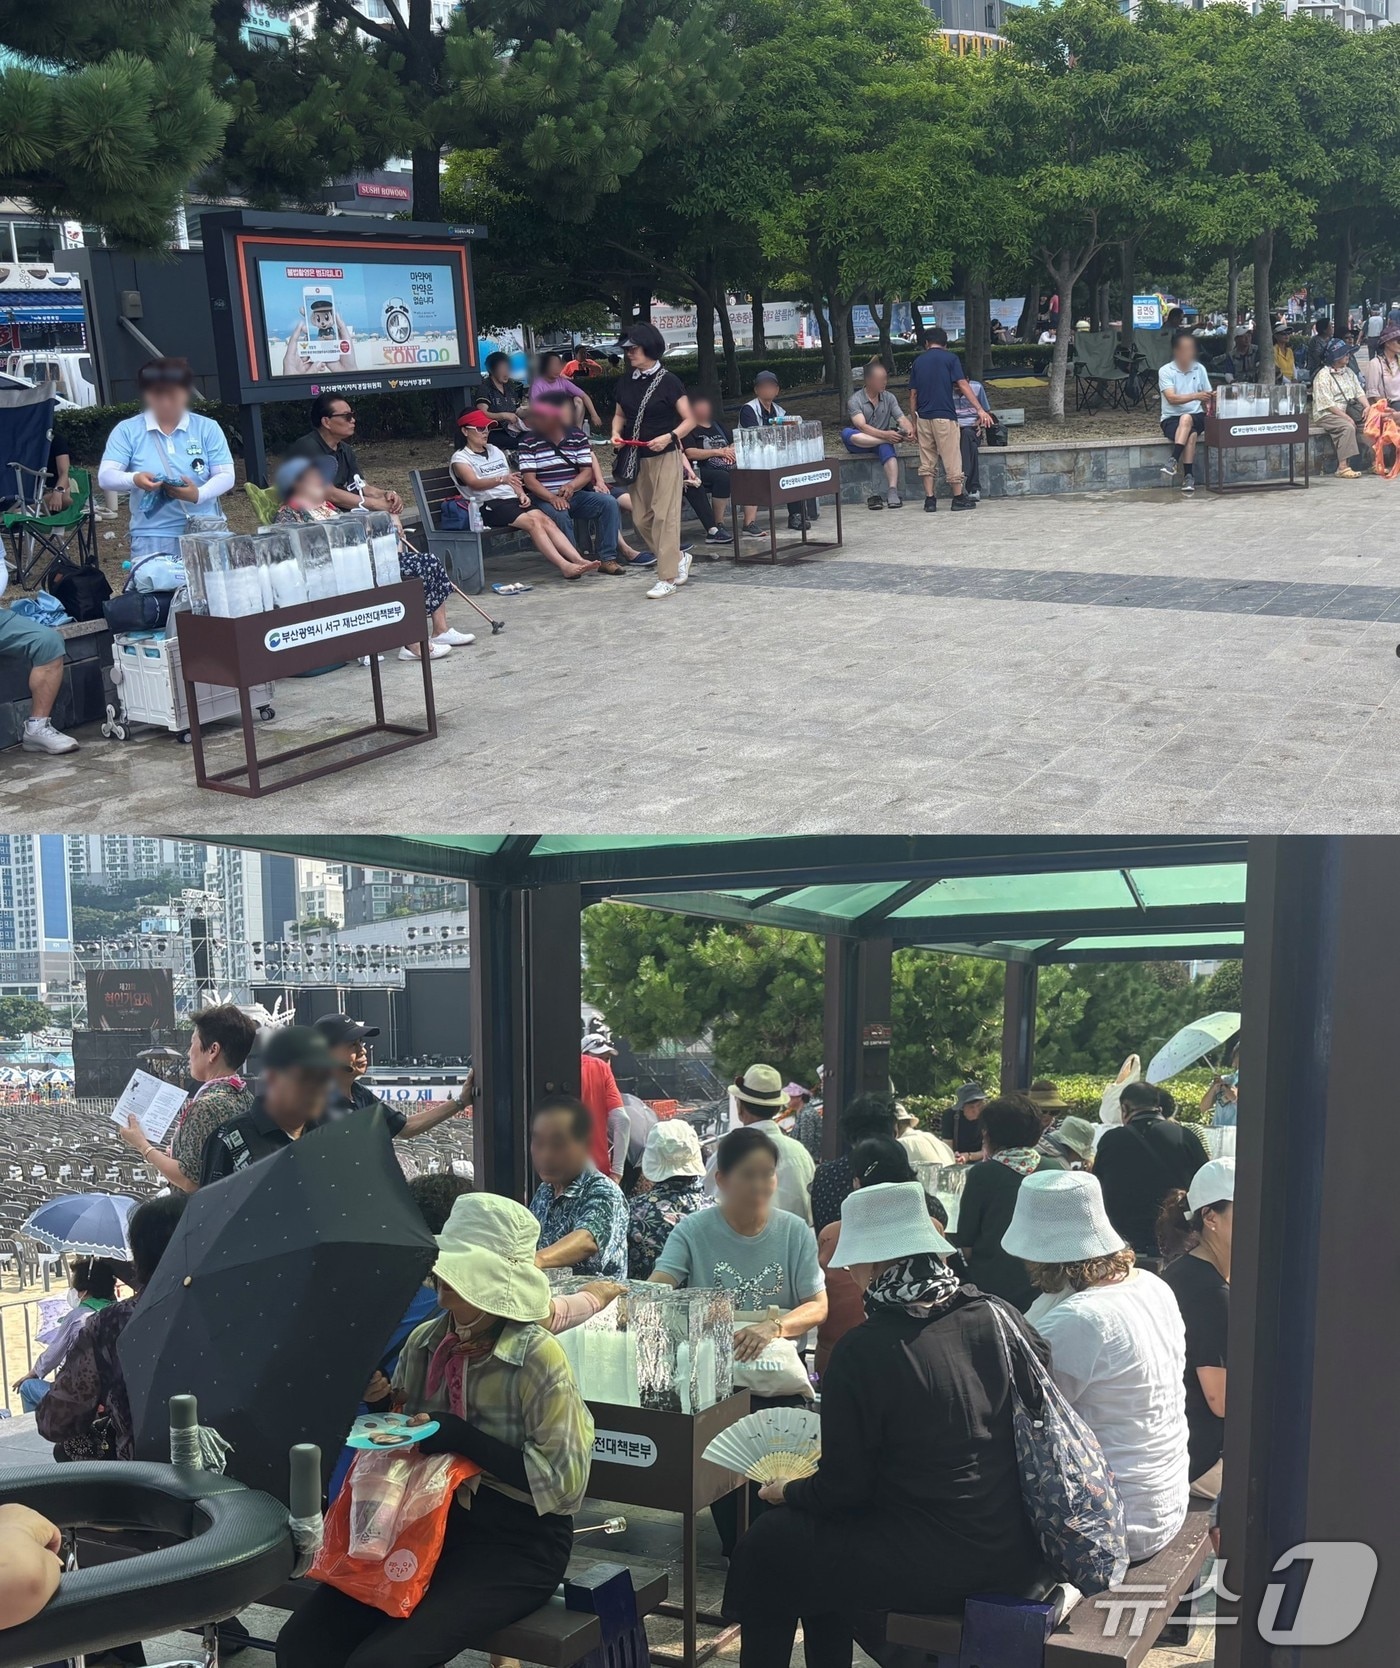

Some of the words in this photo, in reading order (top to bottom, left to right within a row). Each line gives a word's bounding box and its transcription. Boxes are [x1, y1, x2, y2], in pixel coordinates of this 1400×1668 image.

[361, 185, 380, 195] SUSHI
[410, 271, 433, 283] 마약에
[412, 284, 434, 295] 만약은
[413, 296, 434, 306] 없습니다
[383, 347, 450, 364] SONGDO
[281, 623, 323, 643] 부산광역시
[325, 619, 341, 632] 서구
[342, 606, 402, 628] 재난안전대책본부
[104, 991, 153, 1008] 현인가요제
[591, 1436, 651, 1460] 전대책본부
